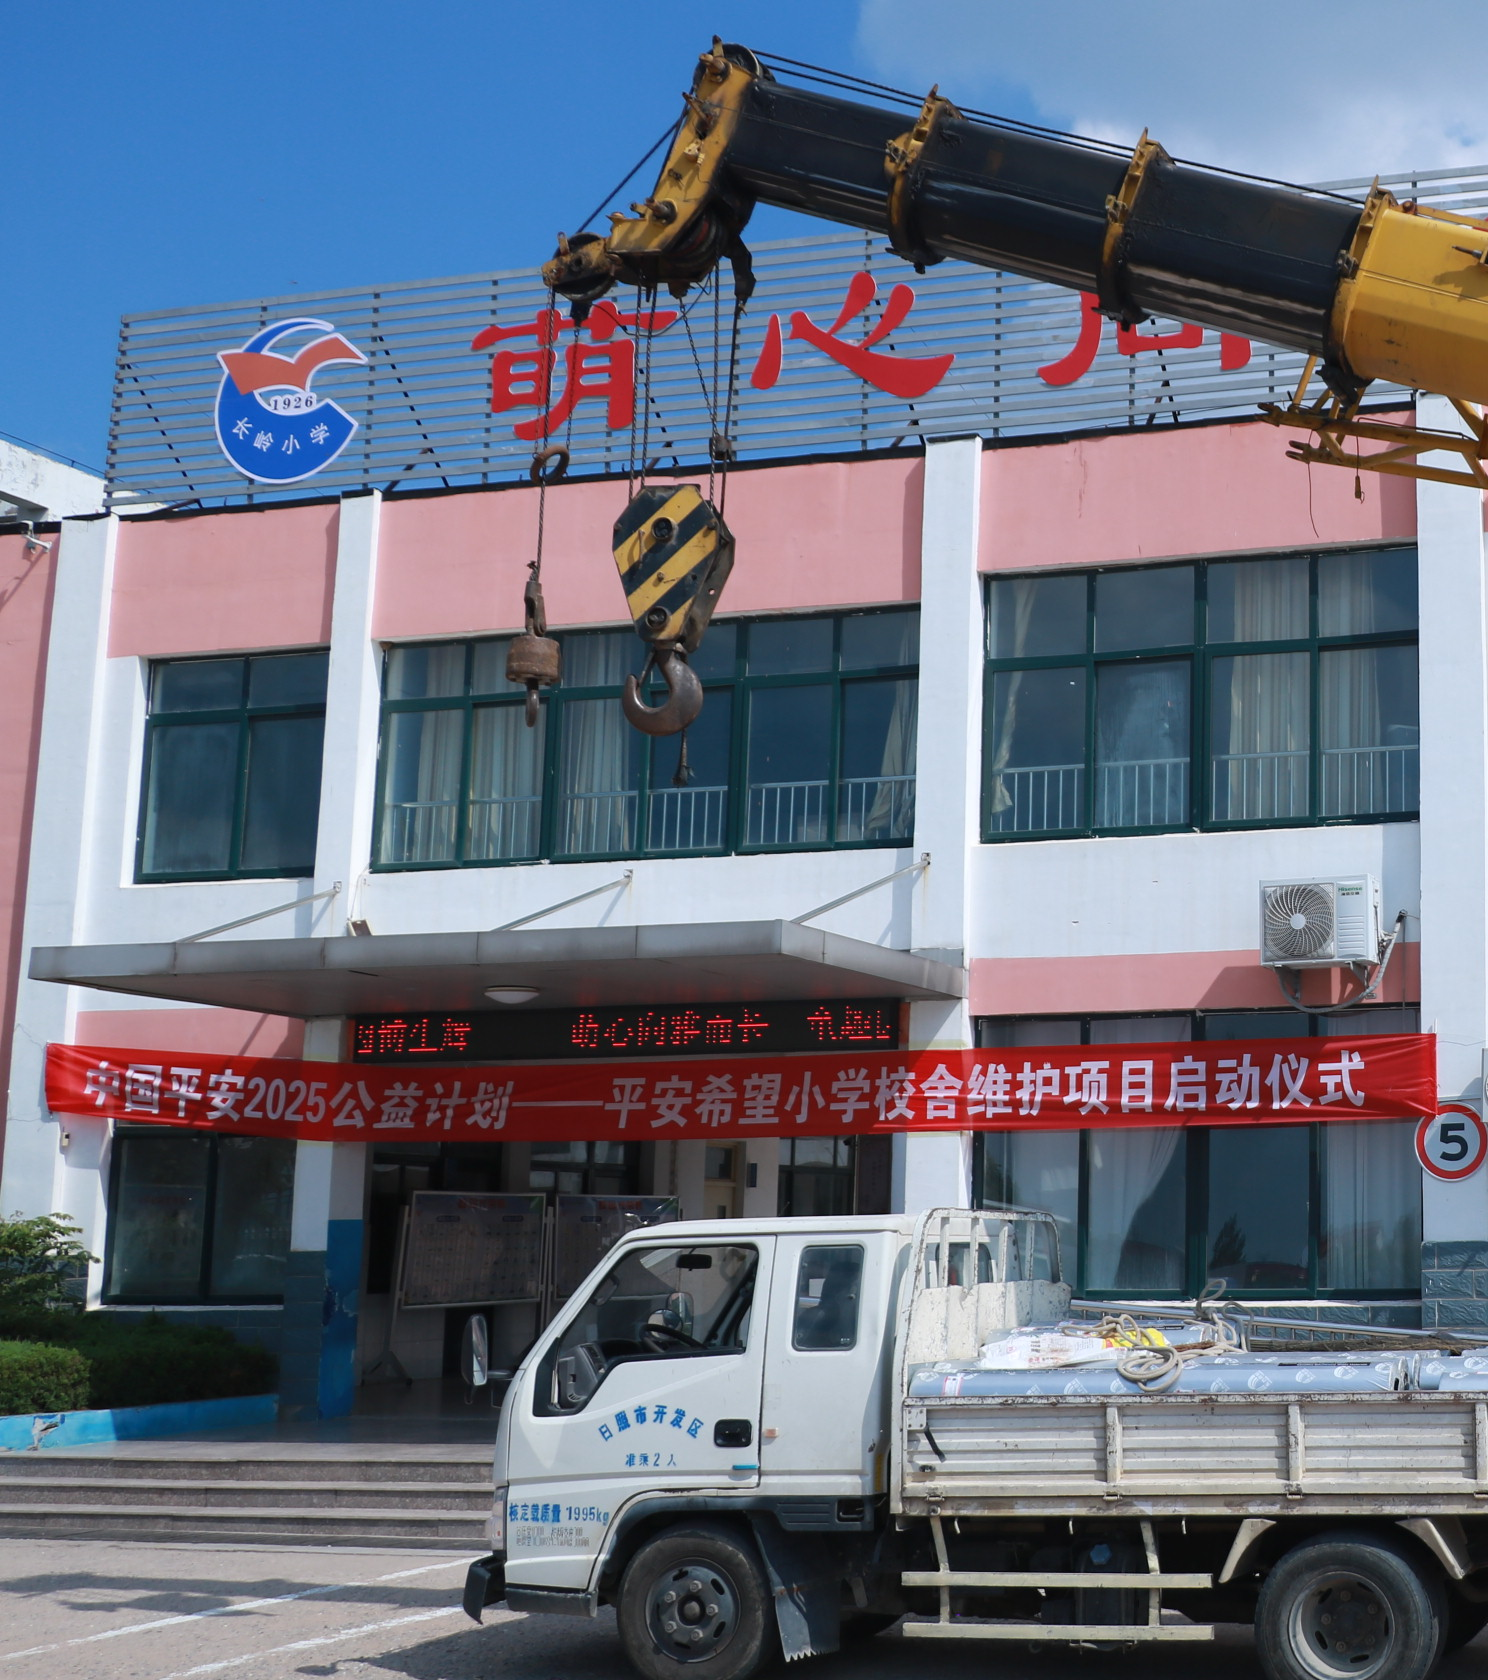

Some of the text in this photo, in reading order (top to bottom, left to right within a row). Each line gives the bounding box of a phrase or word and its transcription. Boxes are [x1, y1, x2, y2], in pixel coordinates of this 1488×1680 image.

[272, 396, 314, 411] 1926
[232, 417, 330, 455] 长岭小学
[84, 1049, 1366, 1131] 中国平安2025公益计划——平安希望小学校舍维护项目启动仪式
[1438, 1122, 1470, 1163] 5
[597, 1404, 704, 1442] 日照市开发区
[508, 1503, 610, 1526] 核定载质量 1995kg
